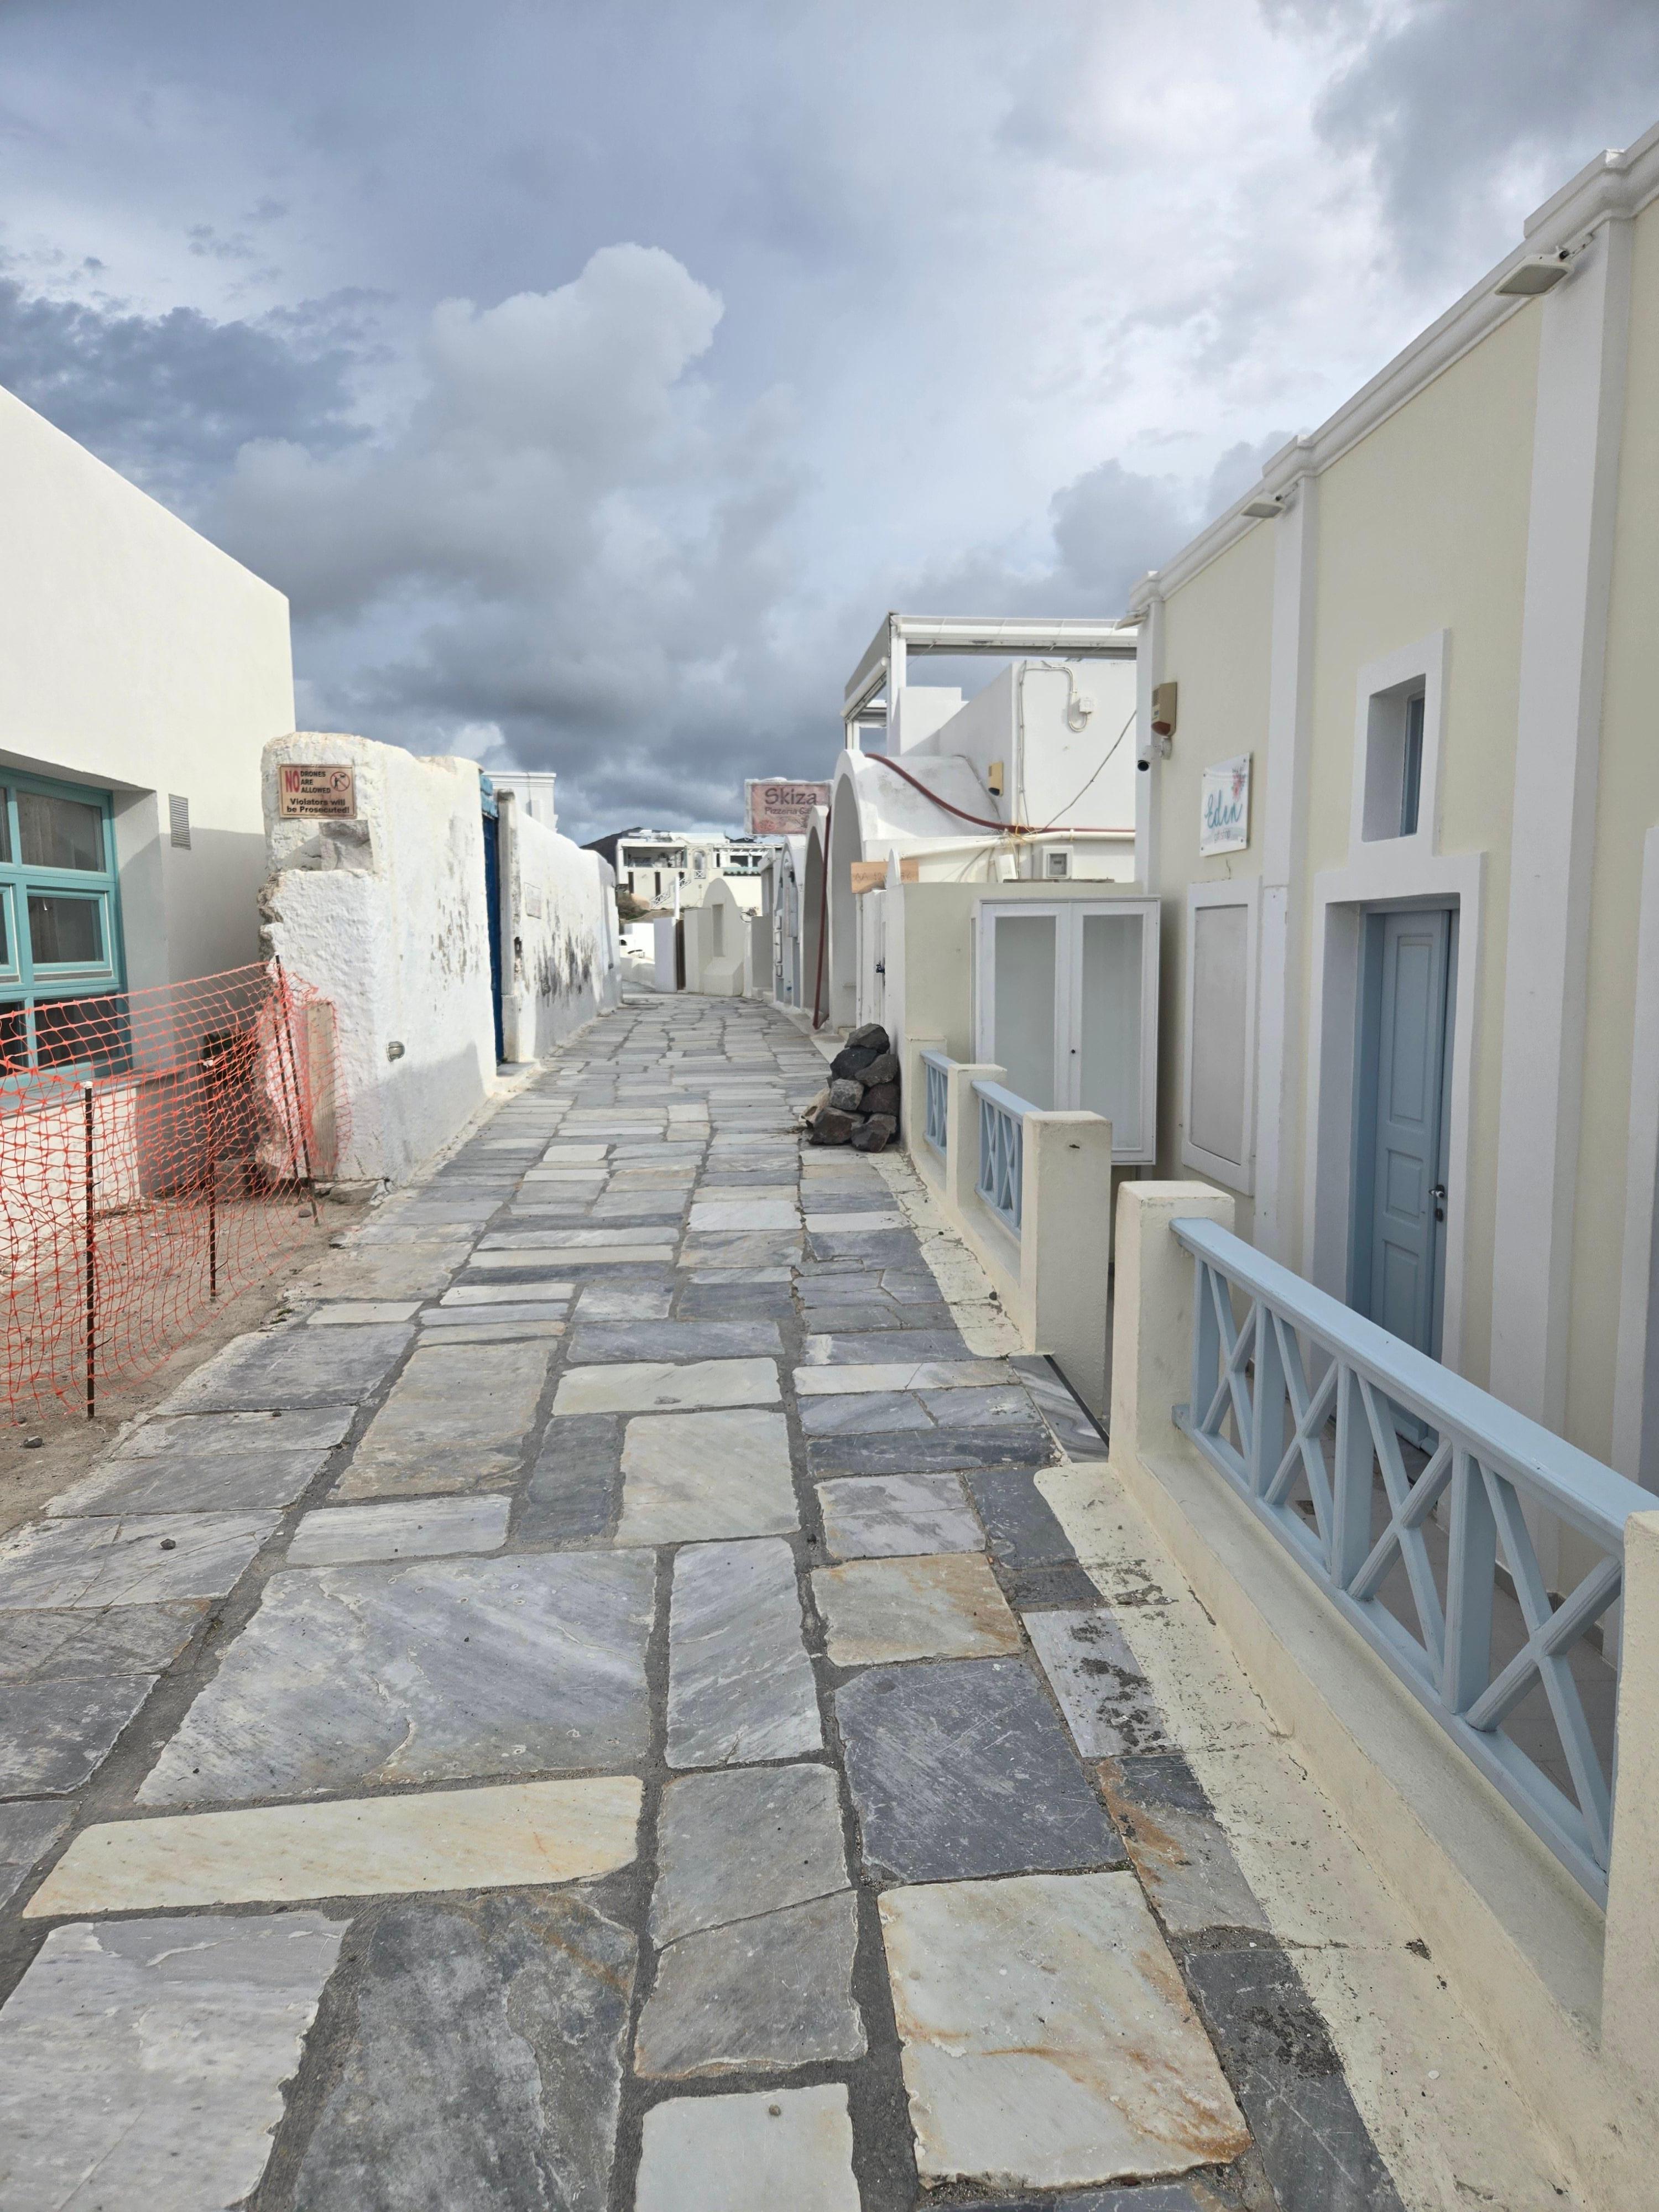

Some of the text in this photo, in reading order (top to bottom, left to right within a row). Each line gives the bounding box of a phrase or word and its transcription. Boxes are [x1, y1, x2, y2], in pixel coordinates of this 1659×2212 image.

[285, 770, 300, 792] NO
[765, 787, 817, 805] Skiza
[1204, 789, 1243, 828] Eden
